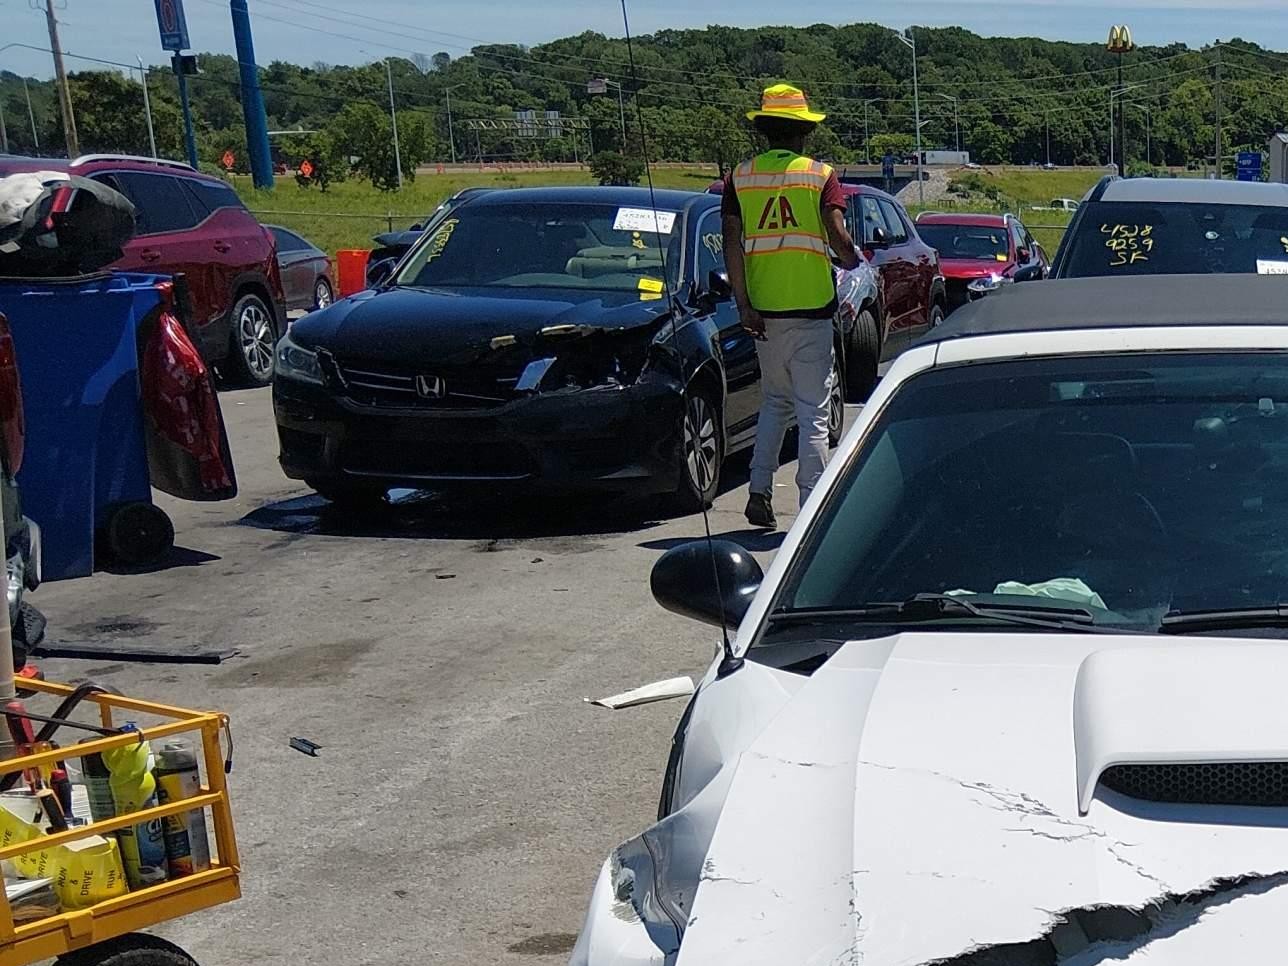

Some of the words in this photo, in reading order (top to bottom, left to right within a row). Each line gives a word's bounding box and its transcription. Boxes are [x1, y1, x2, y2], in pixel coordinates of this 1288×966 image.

[1105, 238, 1153, 251] 9259
[57, 866, 68, 888] RUN
[80, 869, 94, 896] DRIVE
[106, 869, 115, 889] RUN
